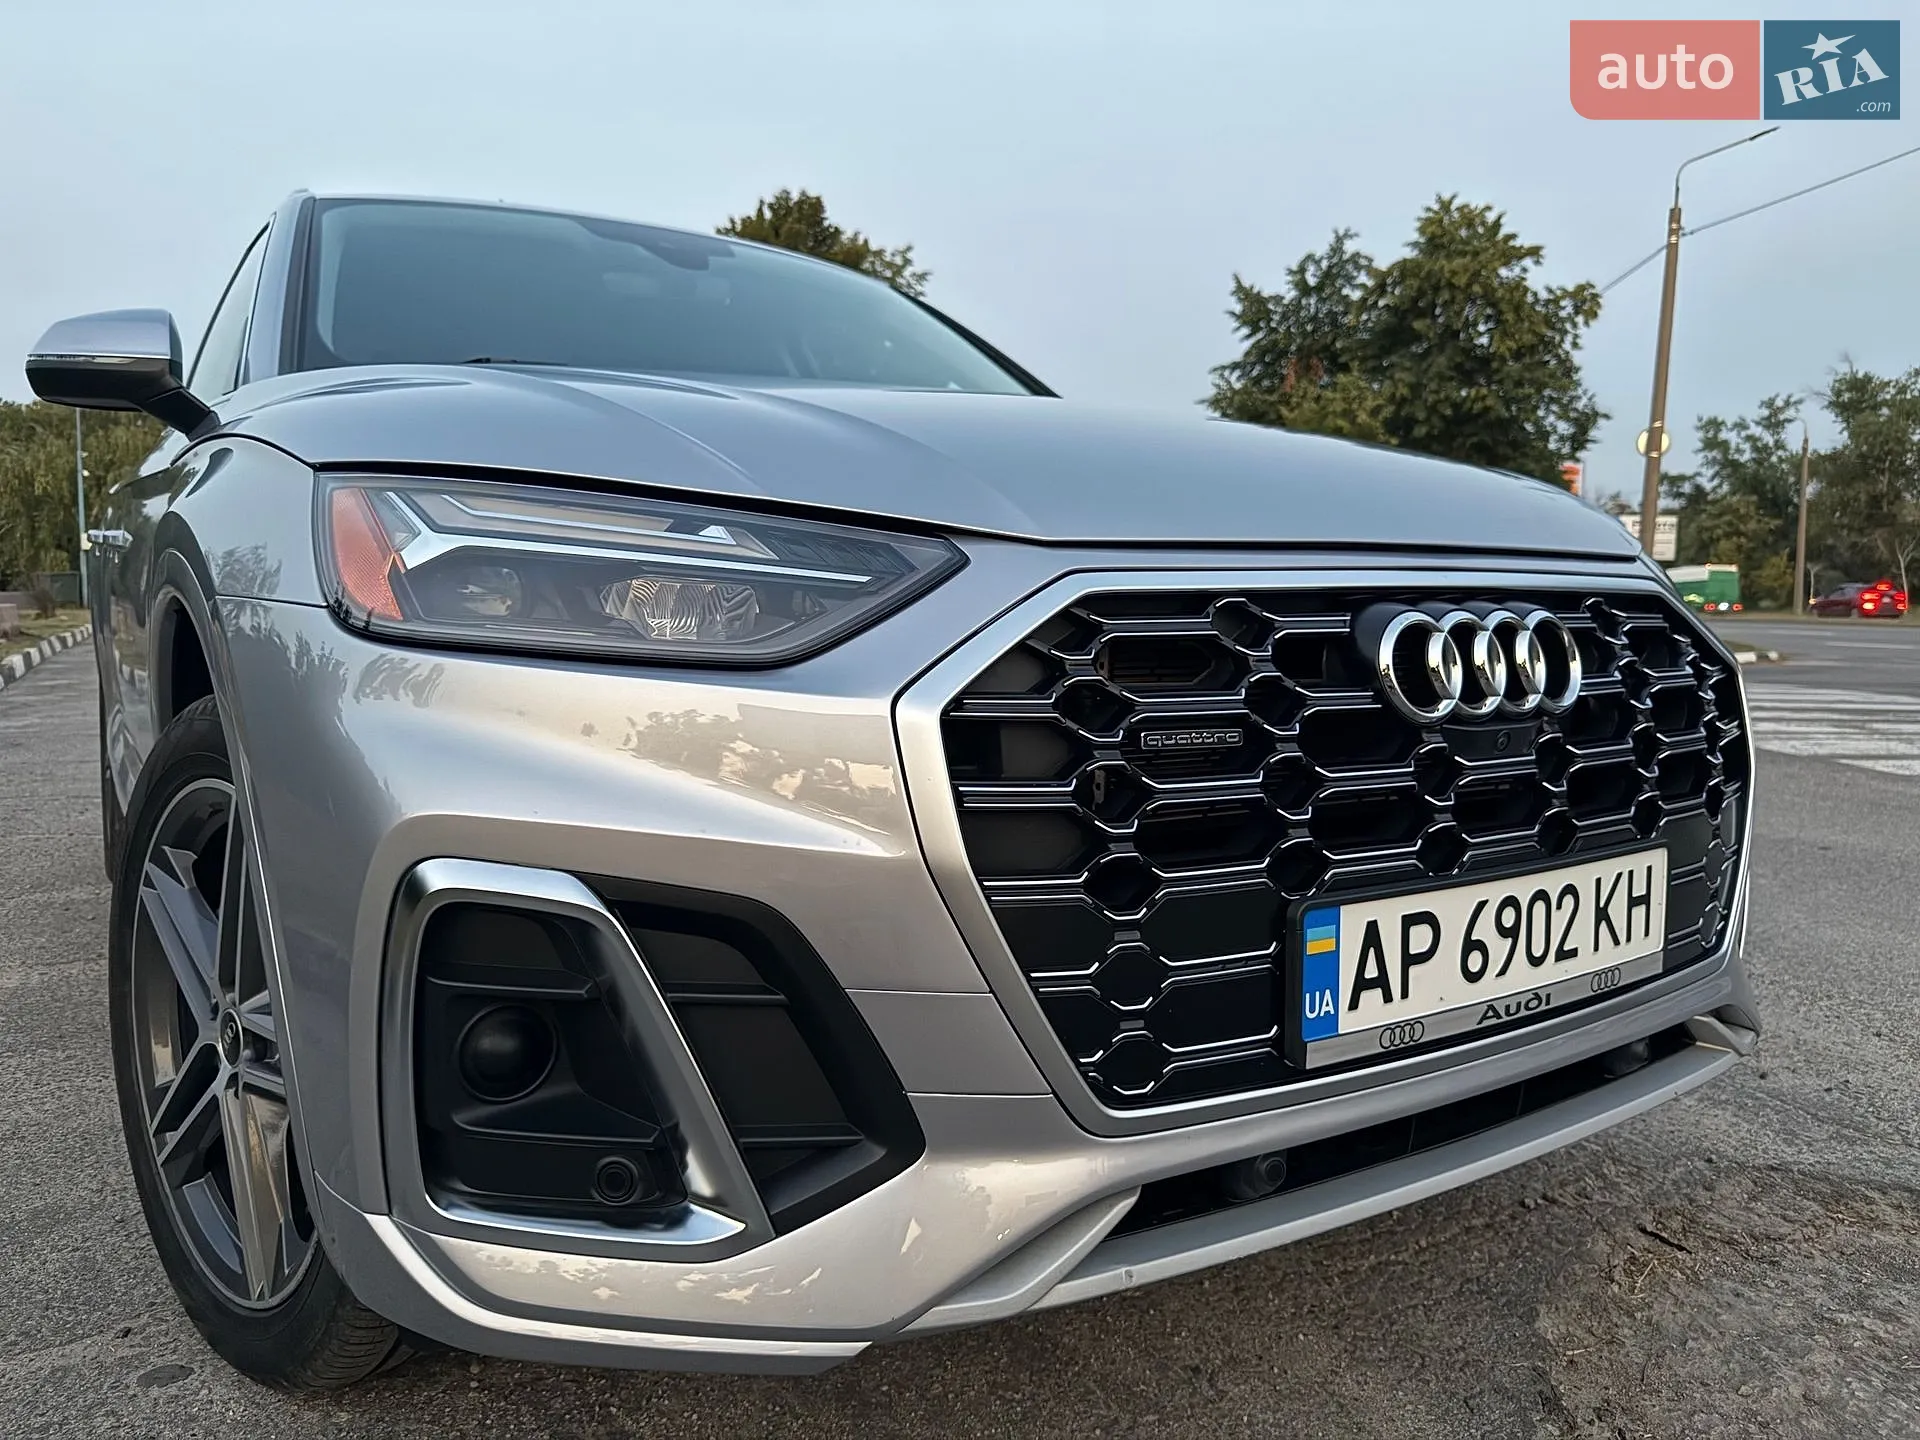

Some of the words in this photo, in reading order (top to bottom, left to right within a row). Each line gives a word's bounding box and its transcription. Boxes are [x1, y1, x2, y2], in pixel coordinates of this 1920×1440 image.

[1147, 733, 1239, 747] quattro
[1347, 910, 1441, 1011] AP
[1460, 883, 1580, 984] 6902
[1593, 865, 1653, 952] KH
[1305, 988, 1335, 1019] UA
[1476, 992, 1551, 1025] Audi
